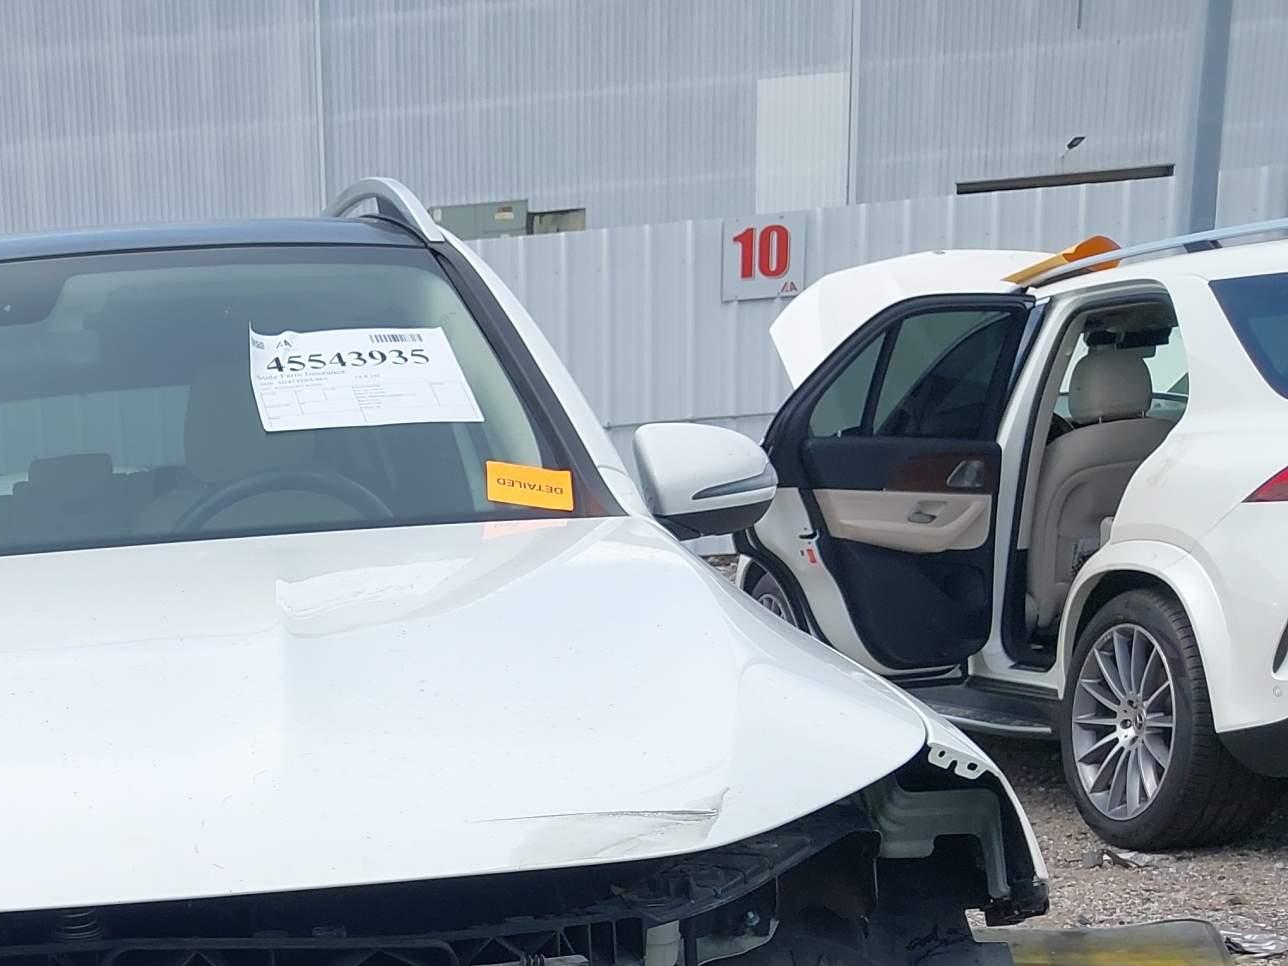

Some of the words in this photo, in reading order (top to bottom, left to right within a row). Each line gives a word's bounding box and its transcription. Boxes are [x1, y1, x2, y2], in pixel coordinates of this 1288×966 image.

[732, 224, 790, 280] 10
[266, 349, 430, 373] 45543935
[496, 477, 564, 495] DETAILED
